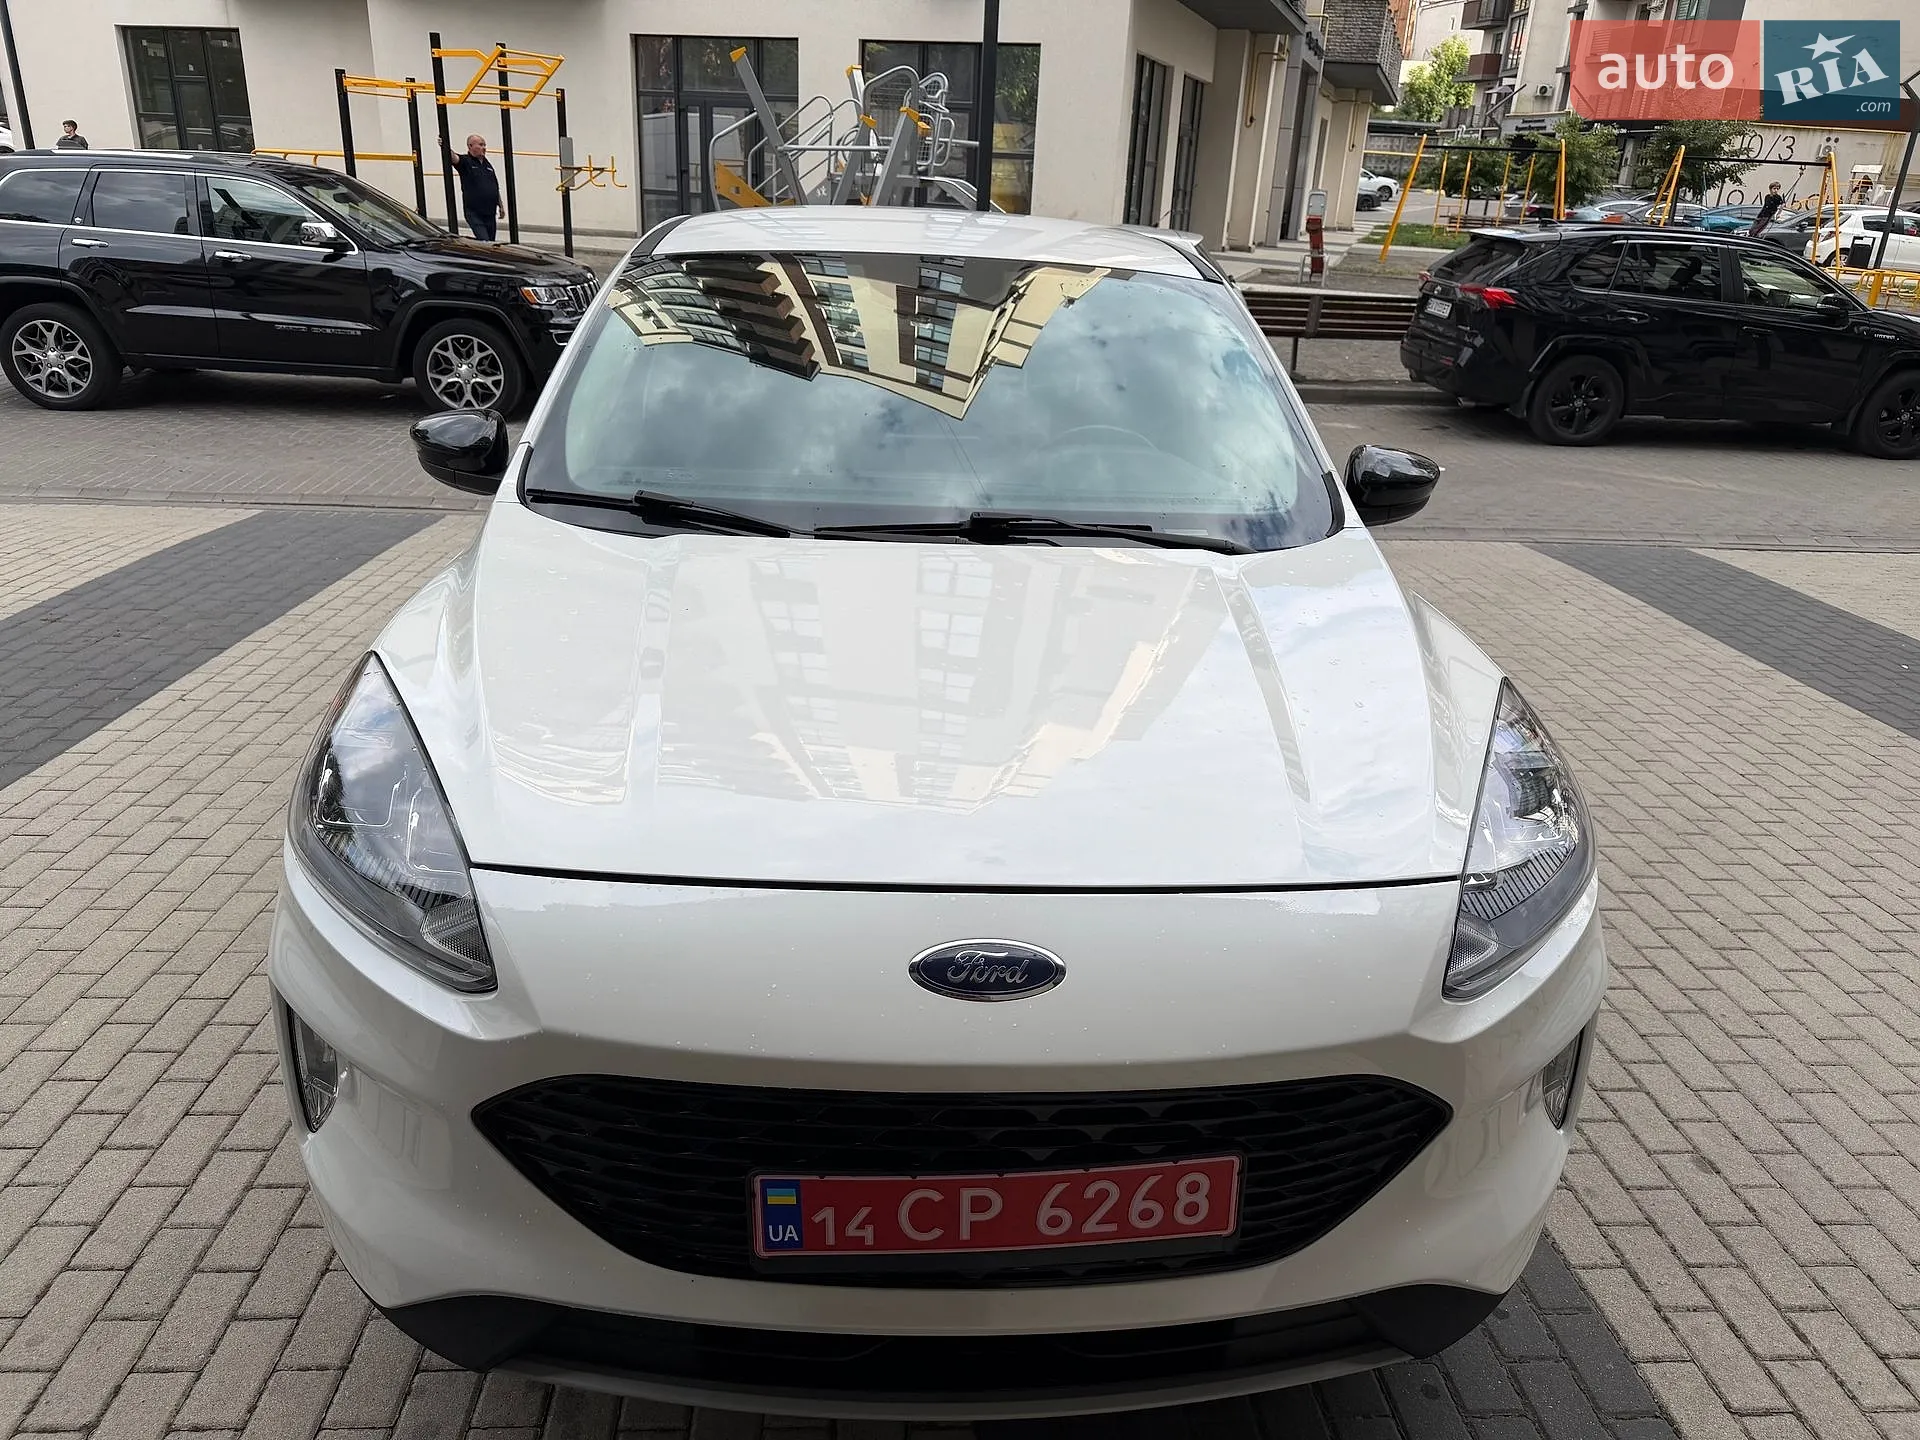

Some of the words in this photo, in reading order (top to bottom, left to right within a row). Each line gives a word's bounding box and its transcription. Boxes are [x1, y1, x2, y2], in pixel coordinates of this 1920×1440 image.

[946, 949, 1031, 984] Ford
[811, 1206, 875, 1246] 14
[897, 1187, 1003, 1242] CP
[1036, 1171, 1211, 1237] 6268
[768, 1224, 799, 1242] UA
